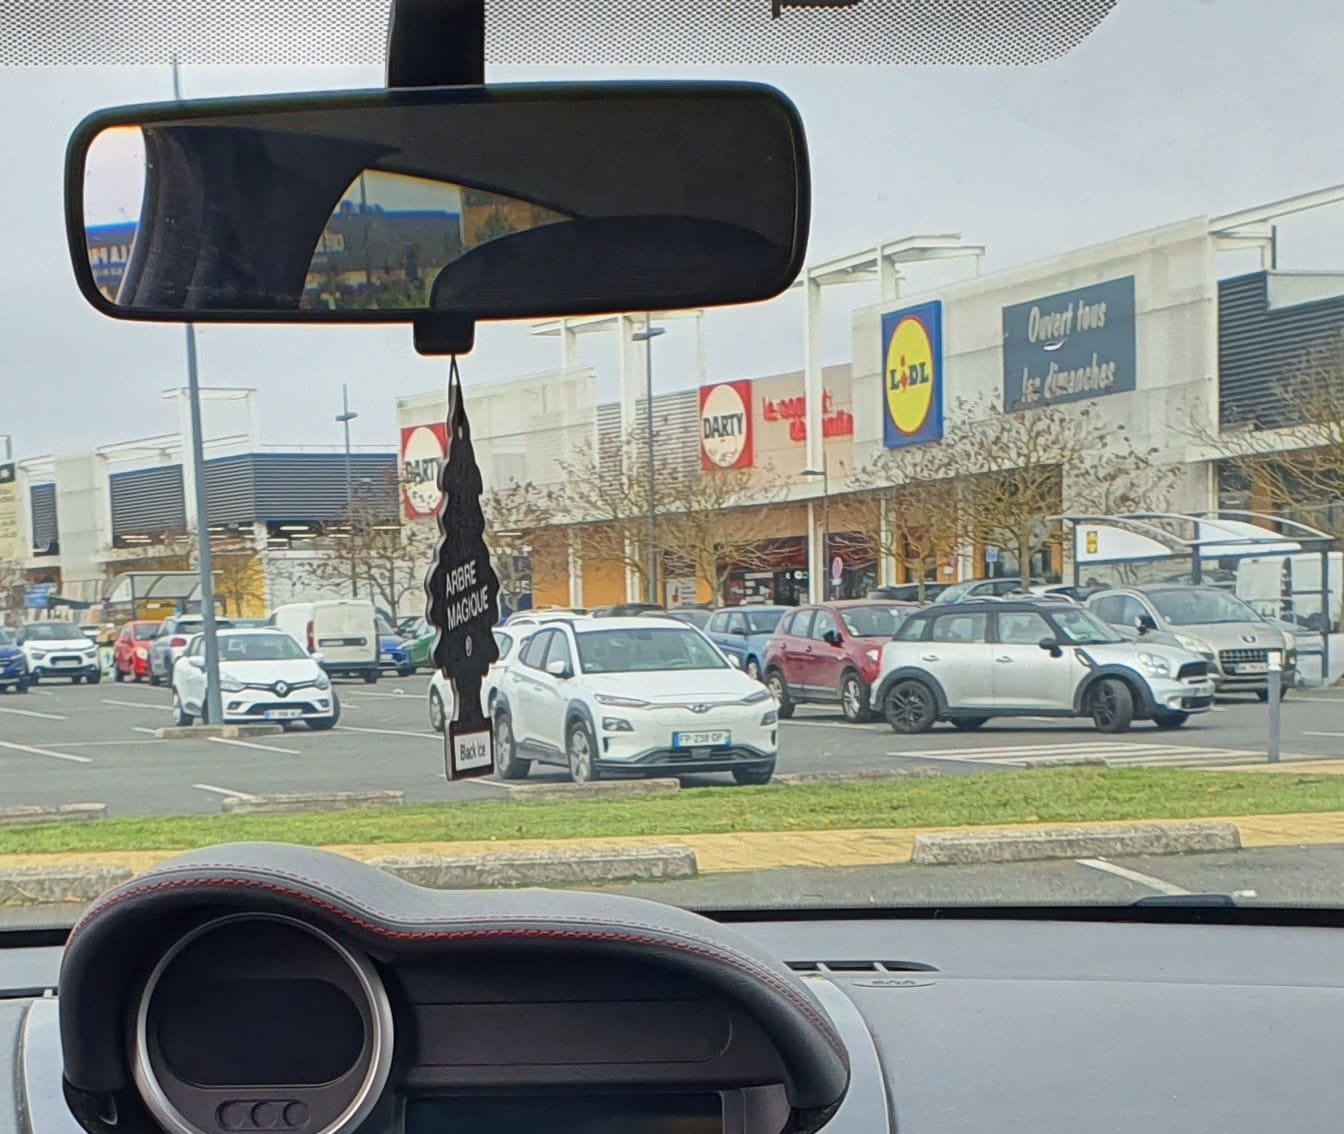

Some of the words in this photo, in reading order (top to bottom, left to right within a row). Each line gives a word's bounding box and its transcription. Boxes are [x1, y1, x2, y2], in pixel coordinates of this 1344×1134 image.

[1028, 302, 1073, 343] Ouvert
[1077, 300, 1107, 331] tous
[1043, 352, 1116, 399] dimanches
[703, 413, 744, 439] DARTY
[445, 559, 477, 599] ARBRE
[447, 585, 489, 632] MAGIQUE
[460, 741, 476, 761] Black
[478, 741, 486, 758] Ice
